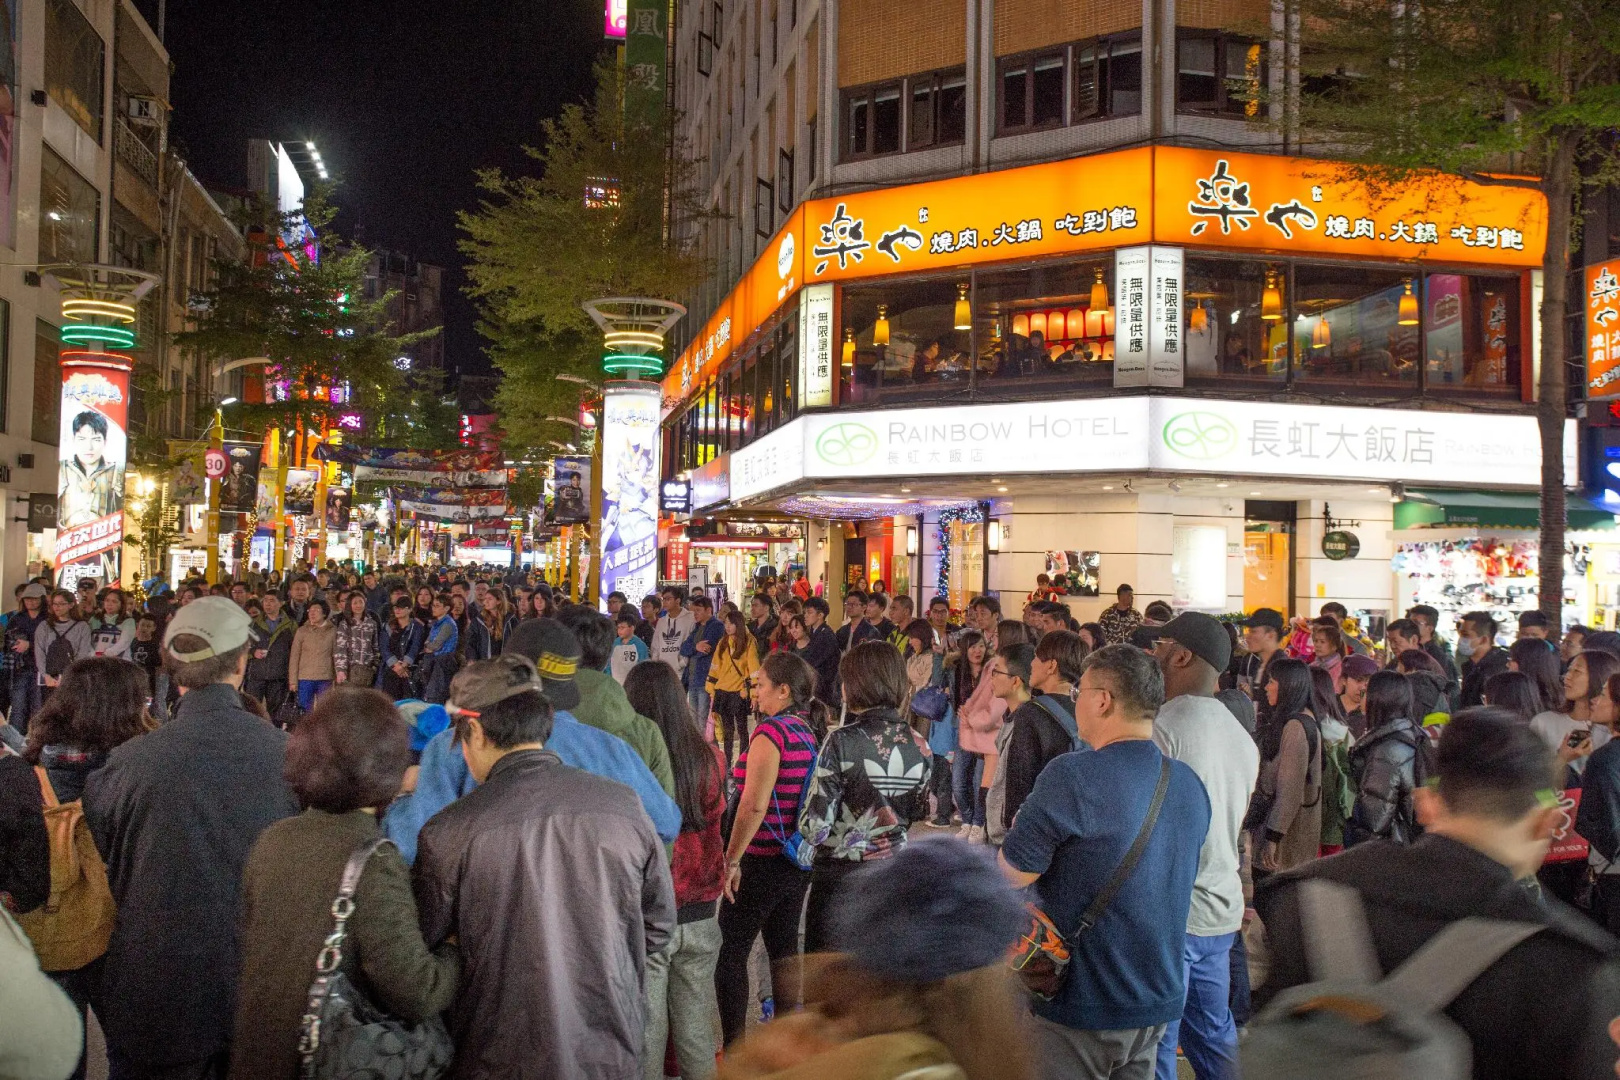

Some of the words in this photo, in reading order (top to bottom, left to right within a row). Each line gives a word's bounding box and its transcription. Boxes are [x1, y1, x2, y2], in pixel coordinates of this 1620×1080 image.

[1055, 206, 1138, 236] 吃到飽
[1450, 223, 1525, 250] 吃到飽
[1129, 277, 1143, 353] 無限量供應
[1164, 277, 1178, 353] 無限量供應
[888, 420, 1013, 444] RAINBOW
[1028, 414, 1129, 439] HOTEL
[1248, 419, 1435, 465] 長虹大飯店
[206, 458, 222, 471] 30
[888, 448, 985, 466] 長虹大飯店
